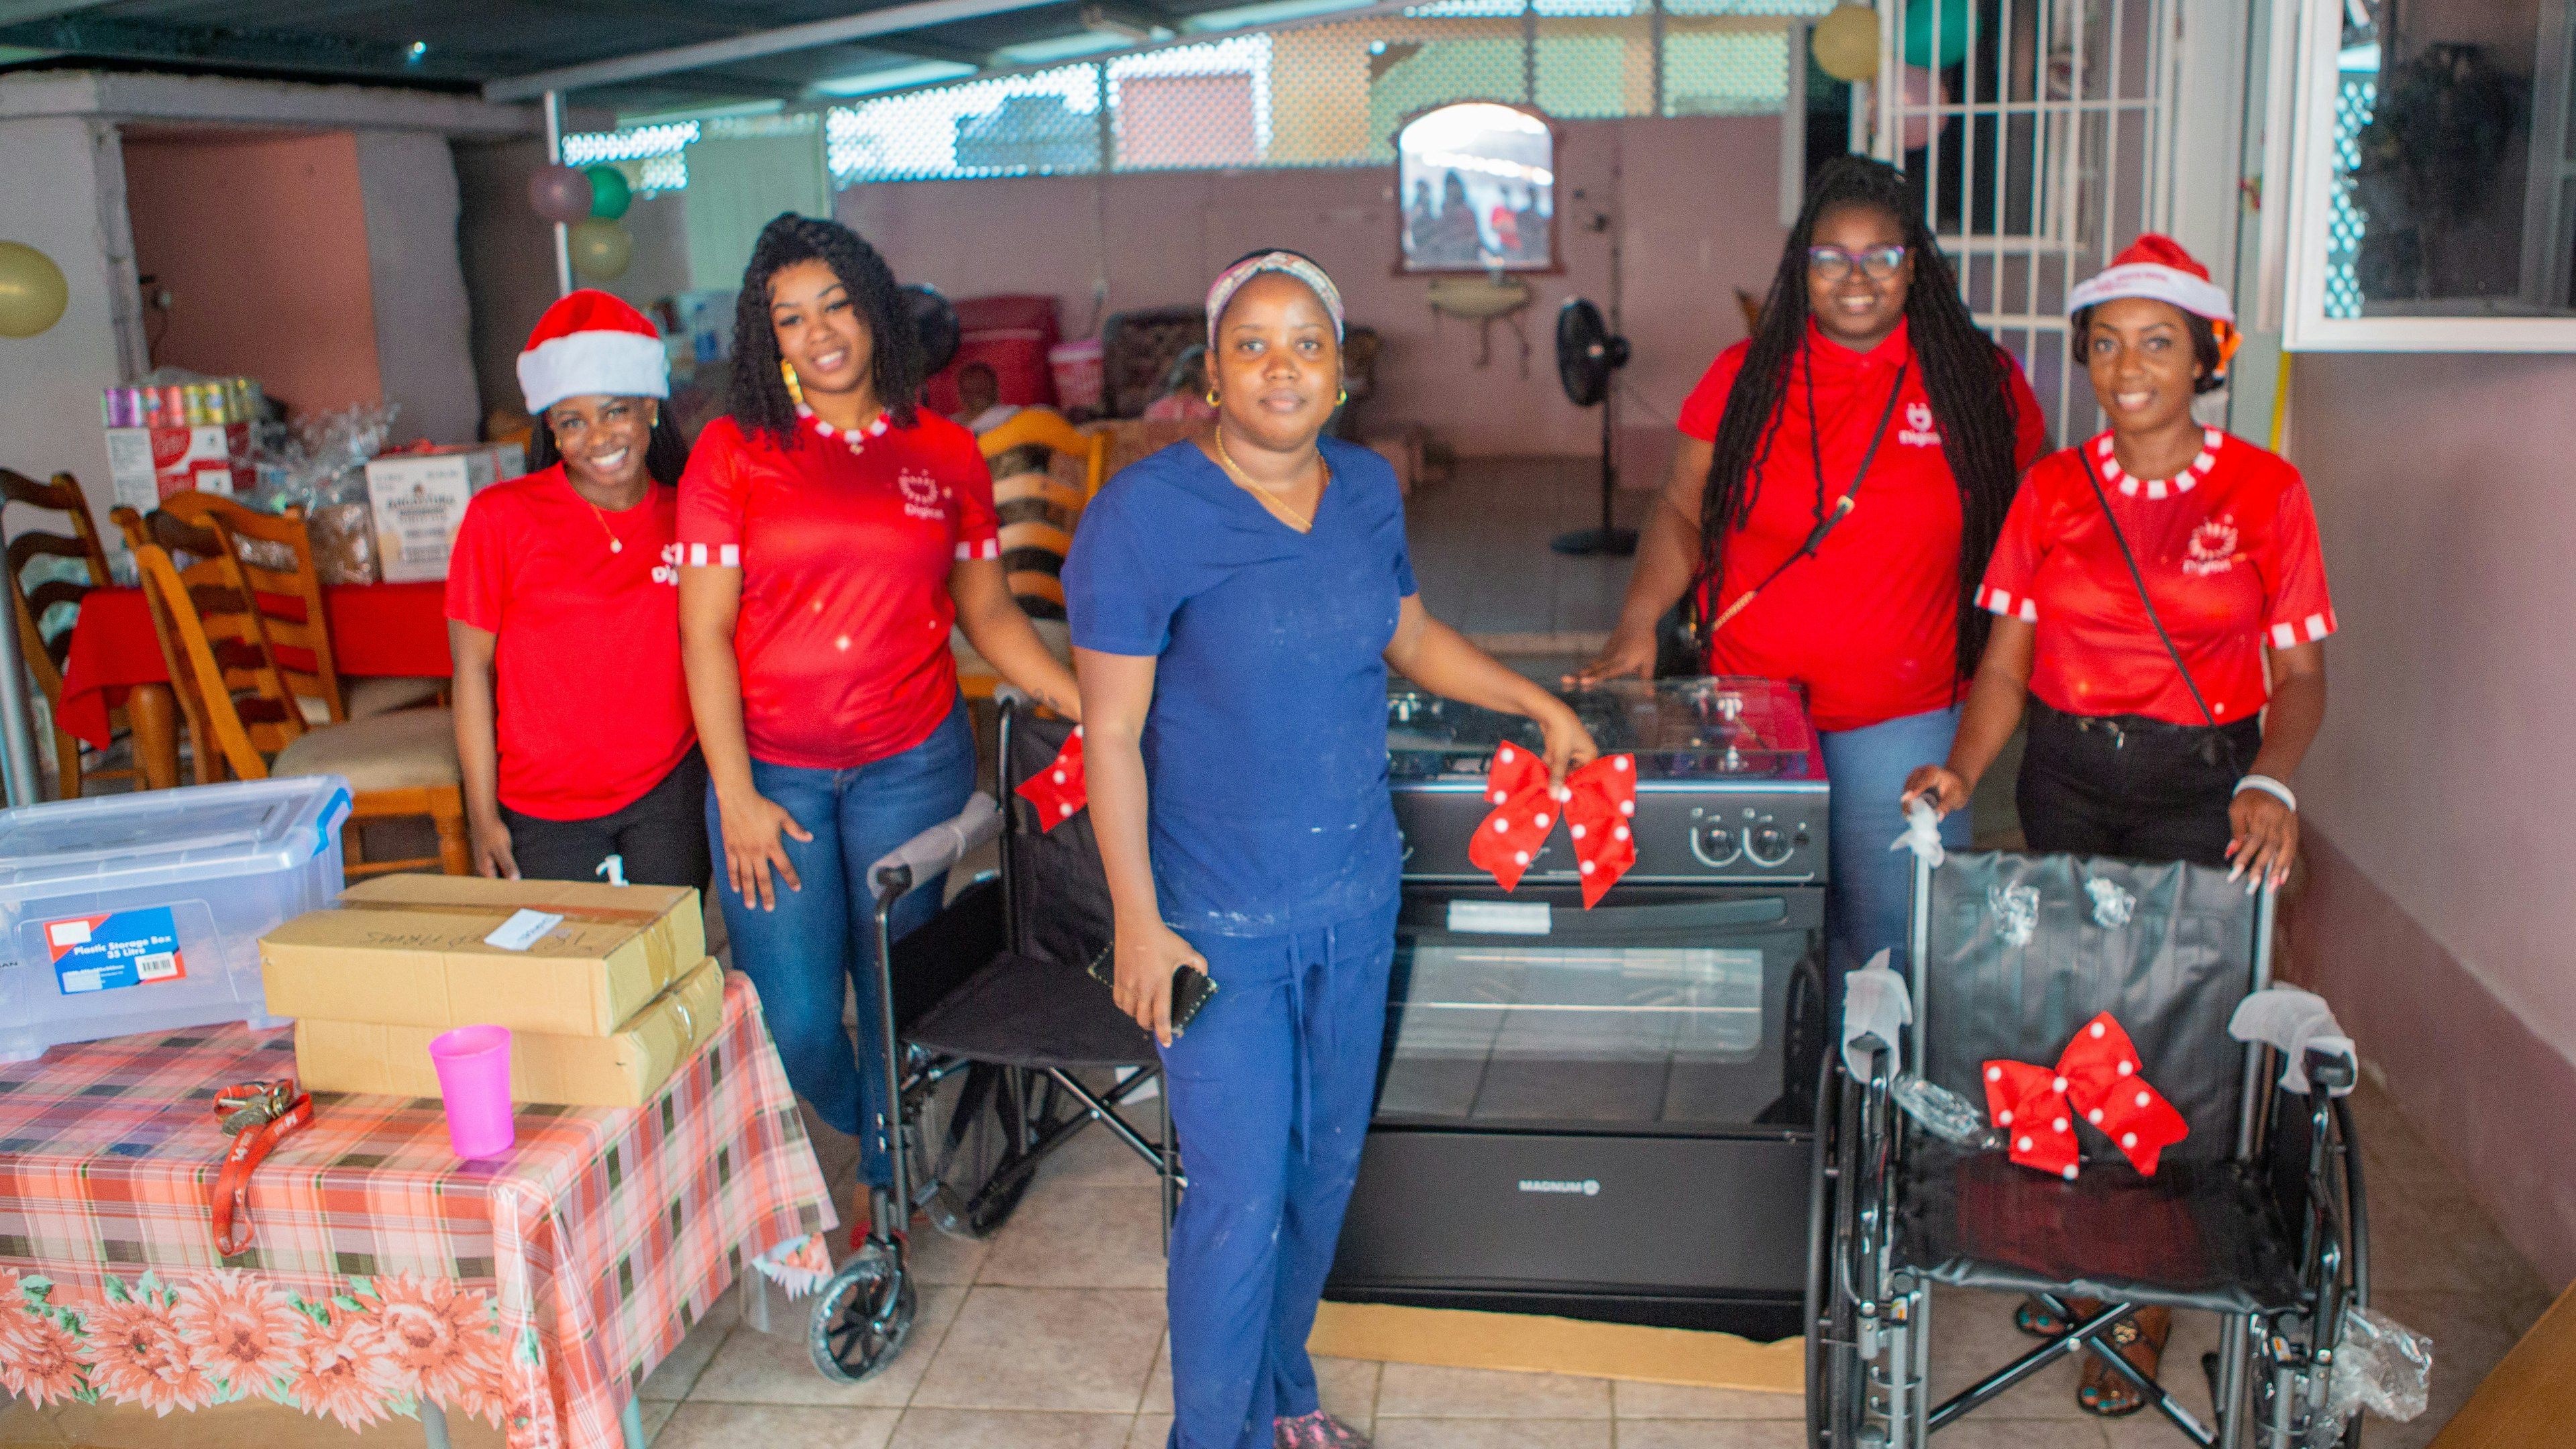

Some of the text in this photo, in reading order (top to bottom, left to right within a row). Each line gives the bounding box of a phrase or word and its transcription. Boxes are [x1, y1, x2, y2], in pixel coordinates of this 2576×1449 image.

[73, 936, 172, 955] Plastic Storage Box
[107, 947, 146, 959] 35 Litre
[1518, 1180, 1582, 1192] MAGNUM
